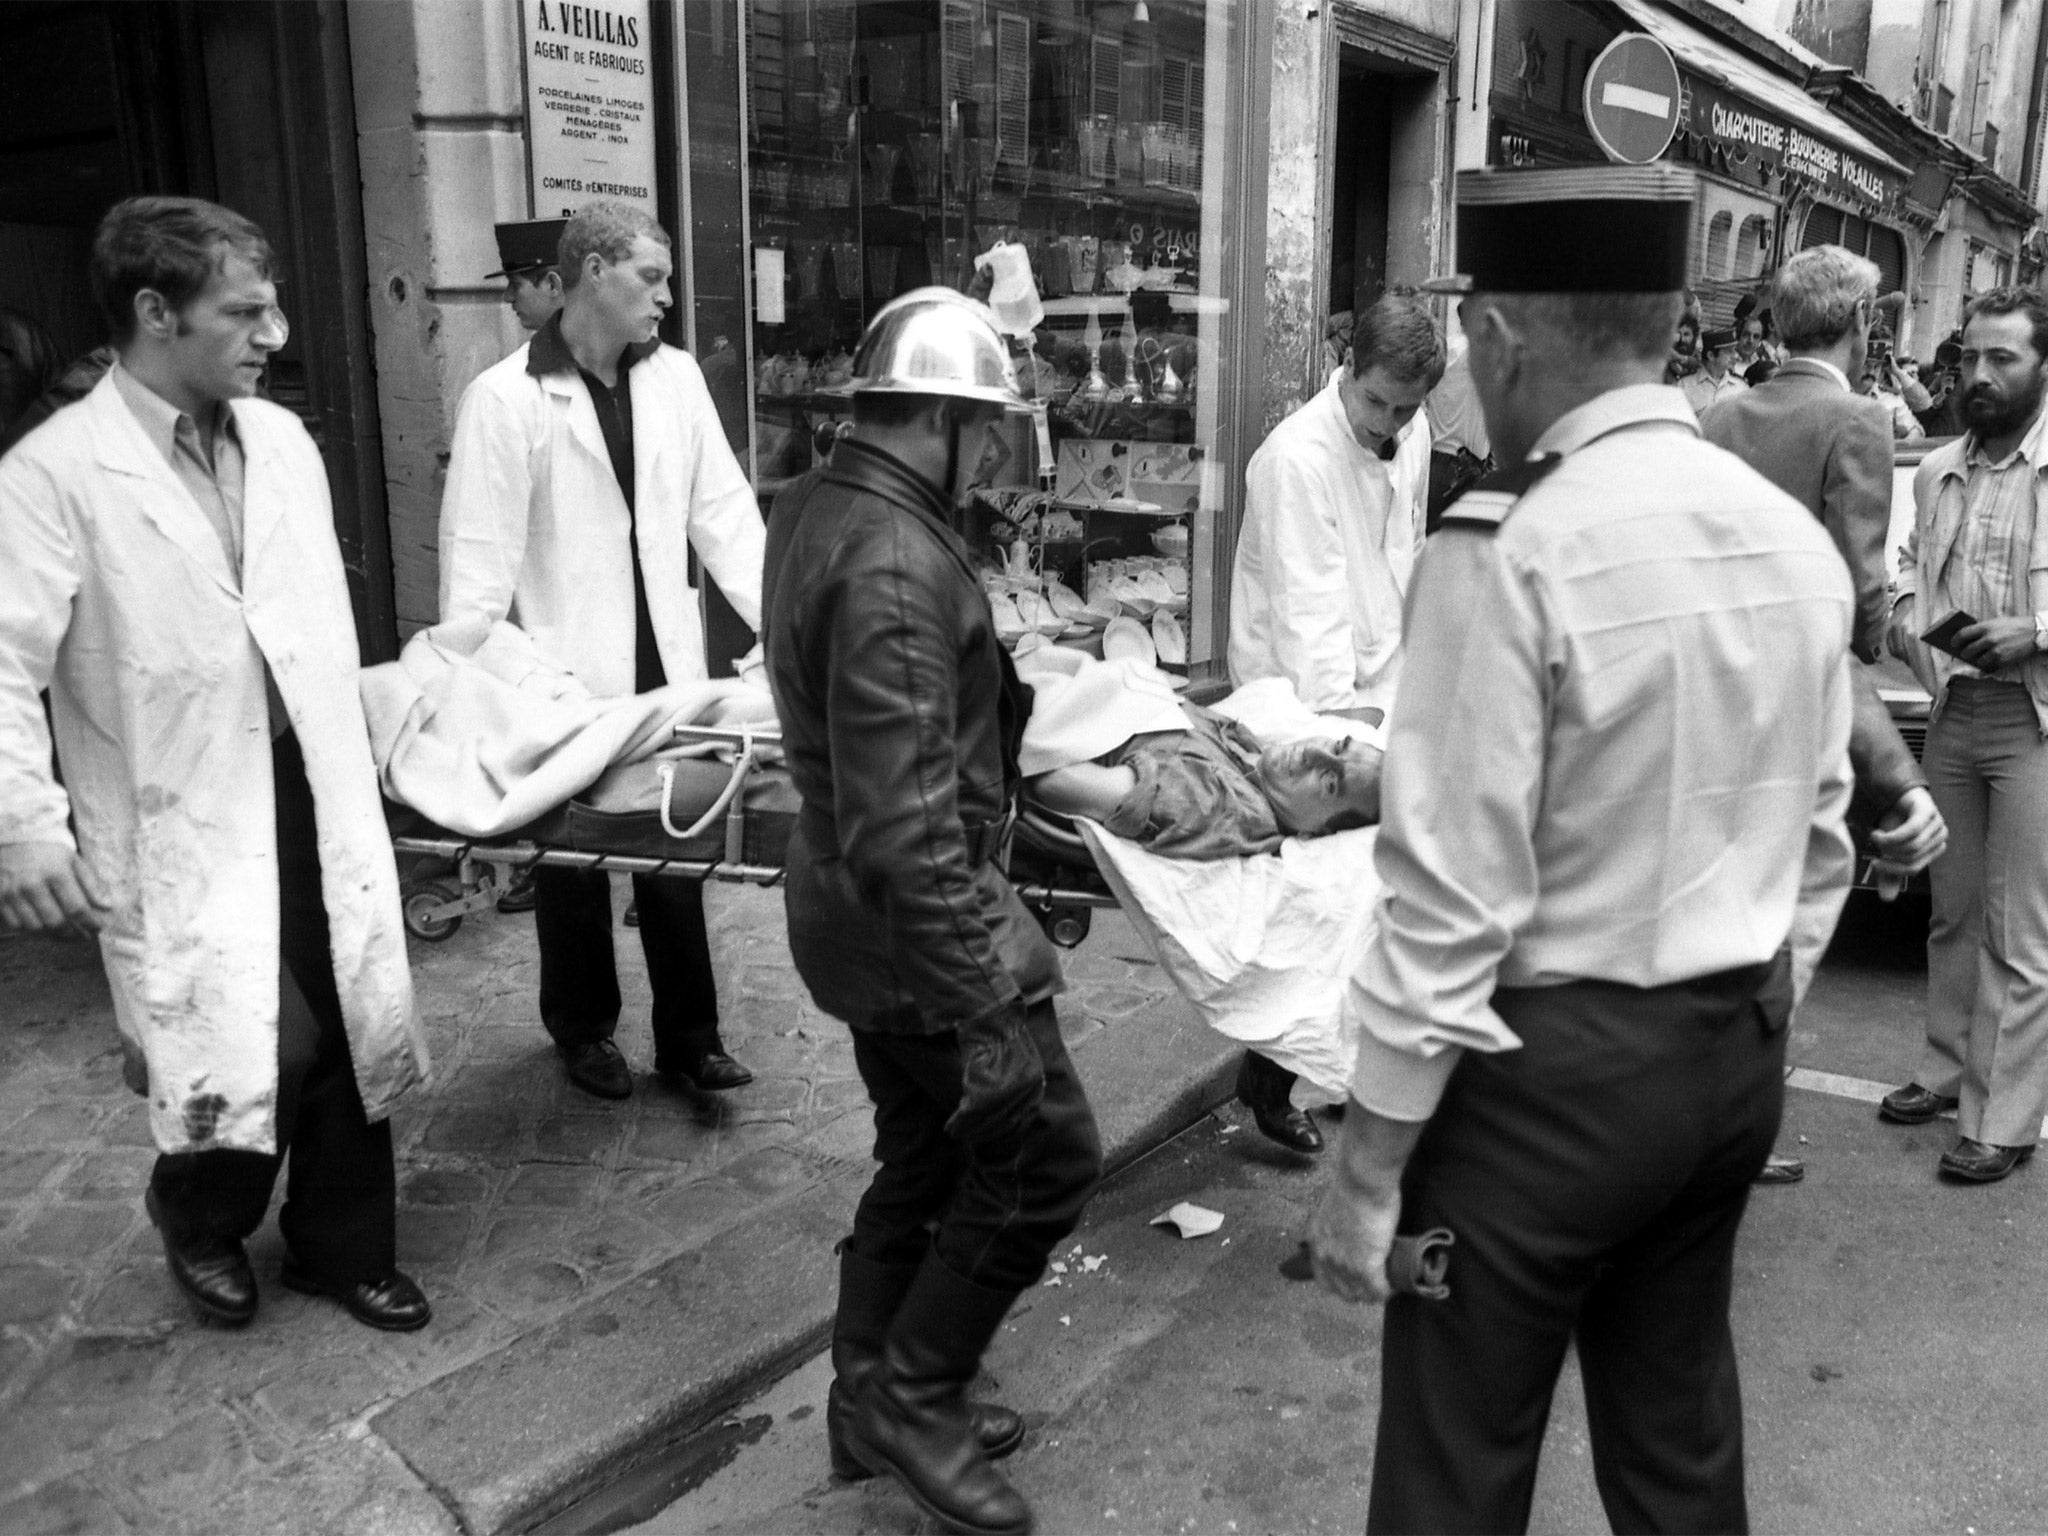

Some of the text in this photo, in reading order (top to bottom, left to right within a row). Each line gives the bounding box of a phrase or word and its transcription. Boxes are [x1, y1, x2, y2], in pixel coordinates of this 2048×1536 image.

[538, 0, 639, 48] A. VEILLAS
[535, 40, 645, 76] AGENT DE FABRIQUES
[539, 86, 645, 111] PORCELAINES LIMOGES
[545, 100, 641, 122] VERRERIE CRISTAUX
[561, 128, 628, 144] ARGENT INOX
[1712, 101, 1785, 152] CHARCUTERIE
[1790, 127, 1838, 174] BOUCHERIE
